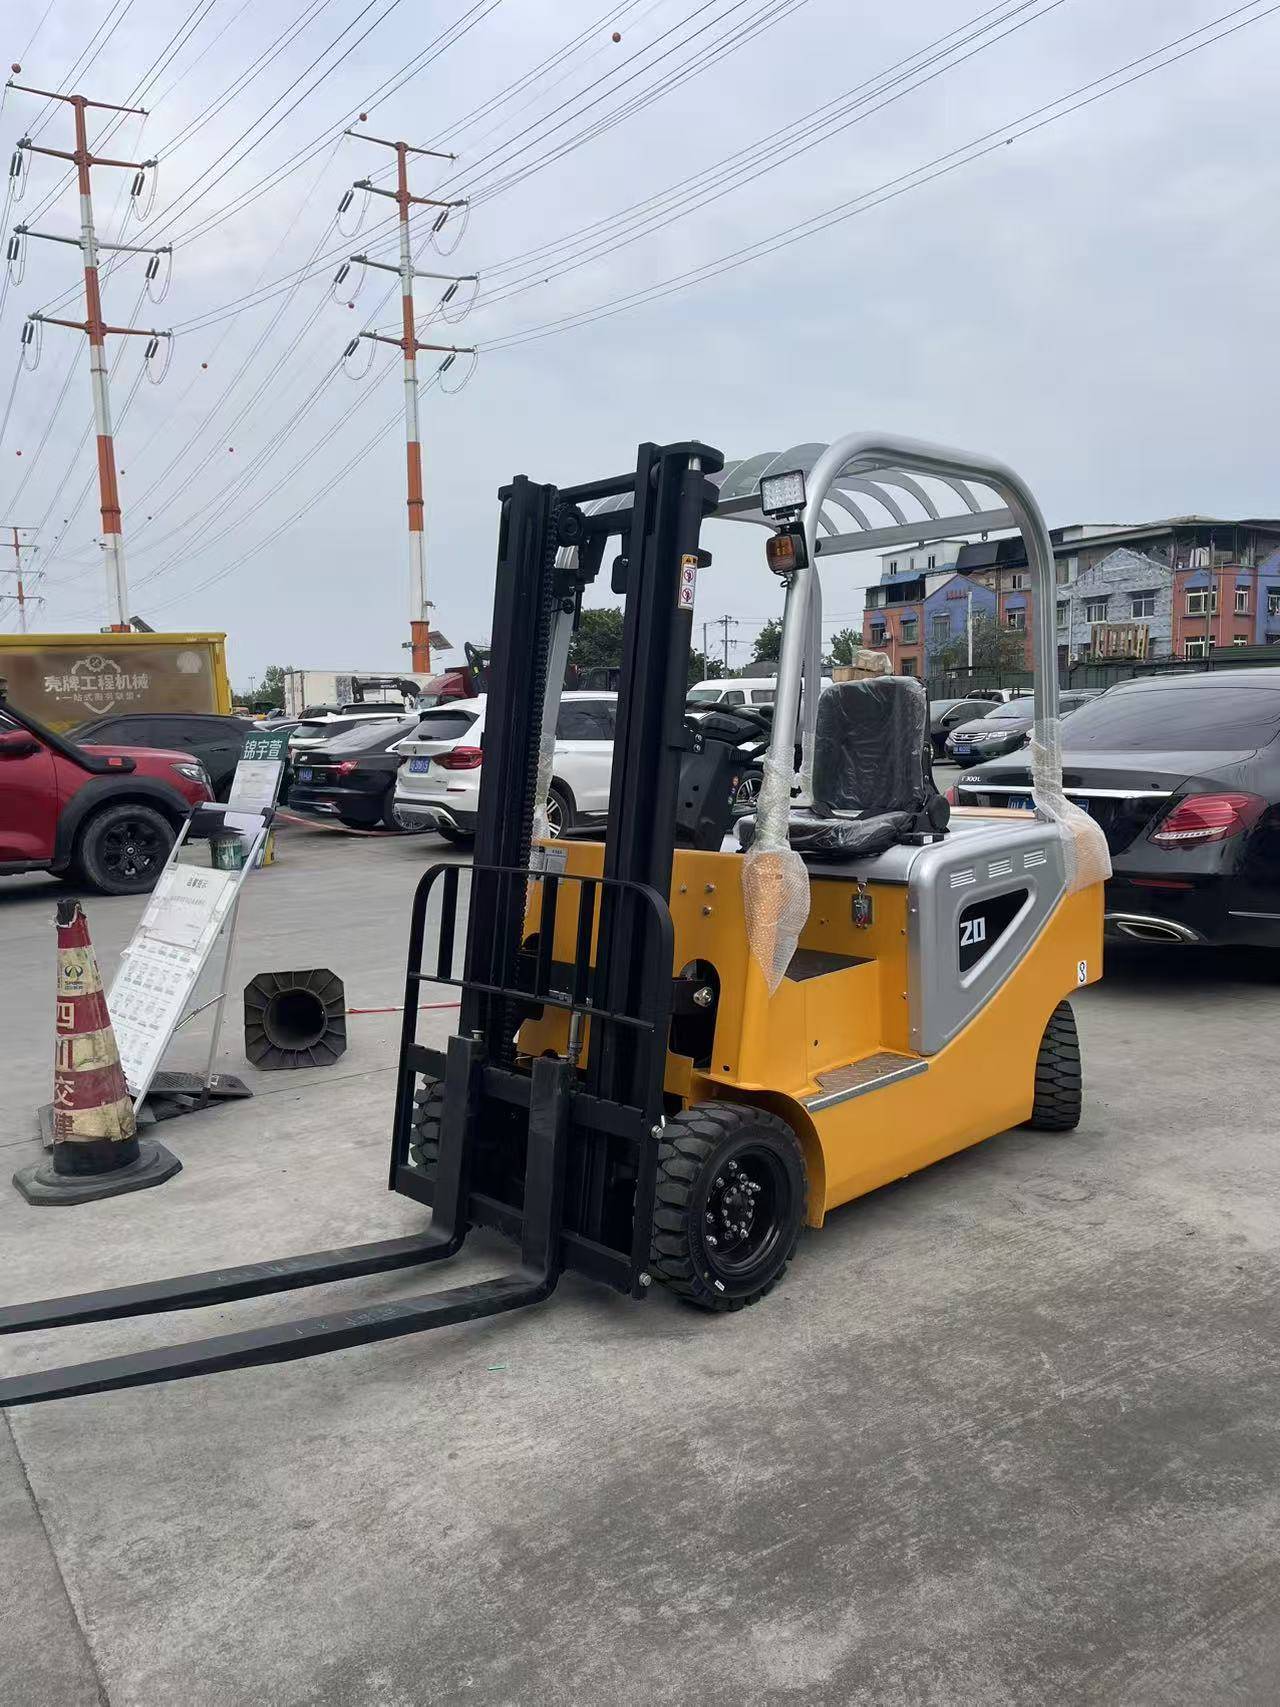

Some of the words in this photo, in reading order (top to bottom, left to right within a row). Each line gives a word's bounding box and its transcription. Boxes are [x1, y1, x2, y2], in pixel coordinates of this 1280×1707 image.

[44, 674, 149, 692] 壳牌工程机械
[960, 917, 986, 947] 20
